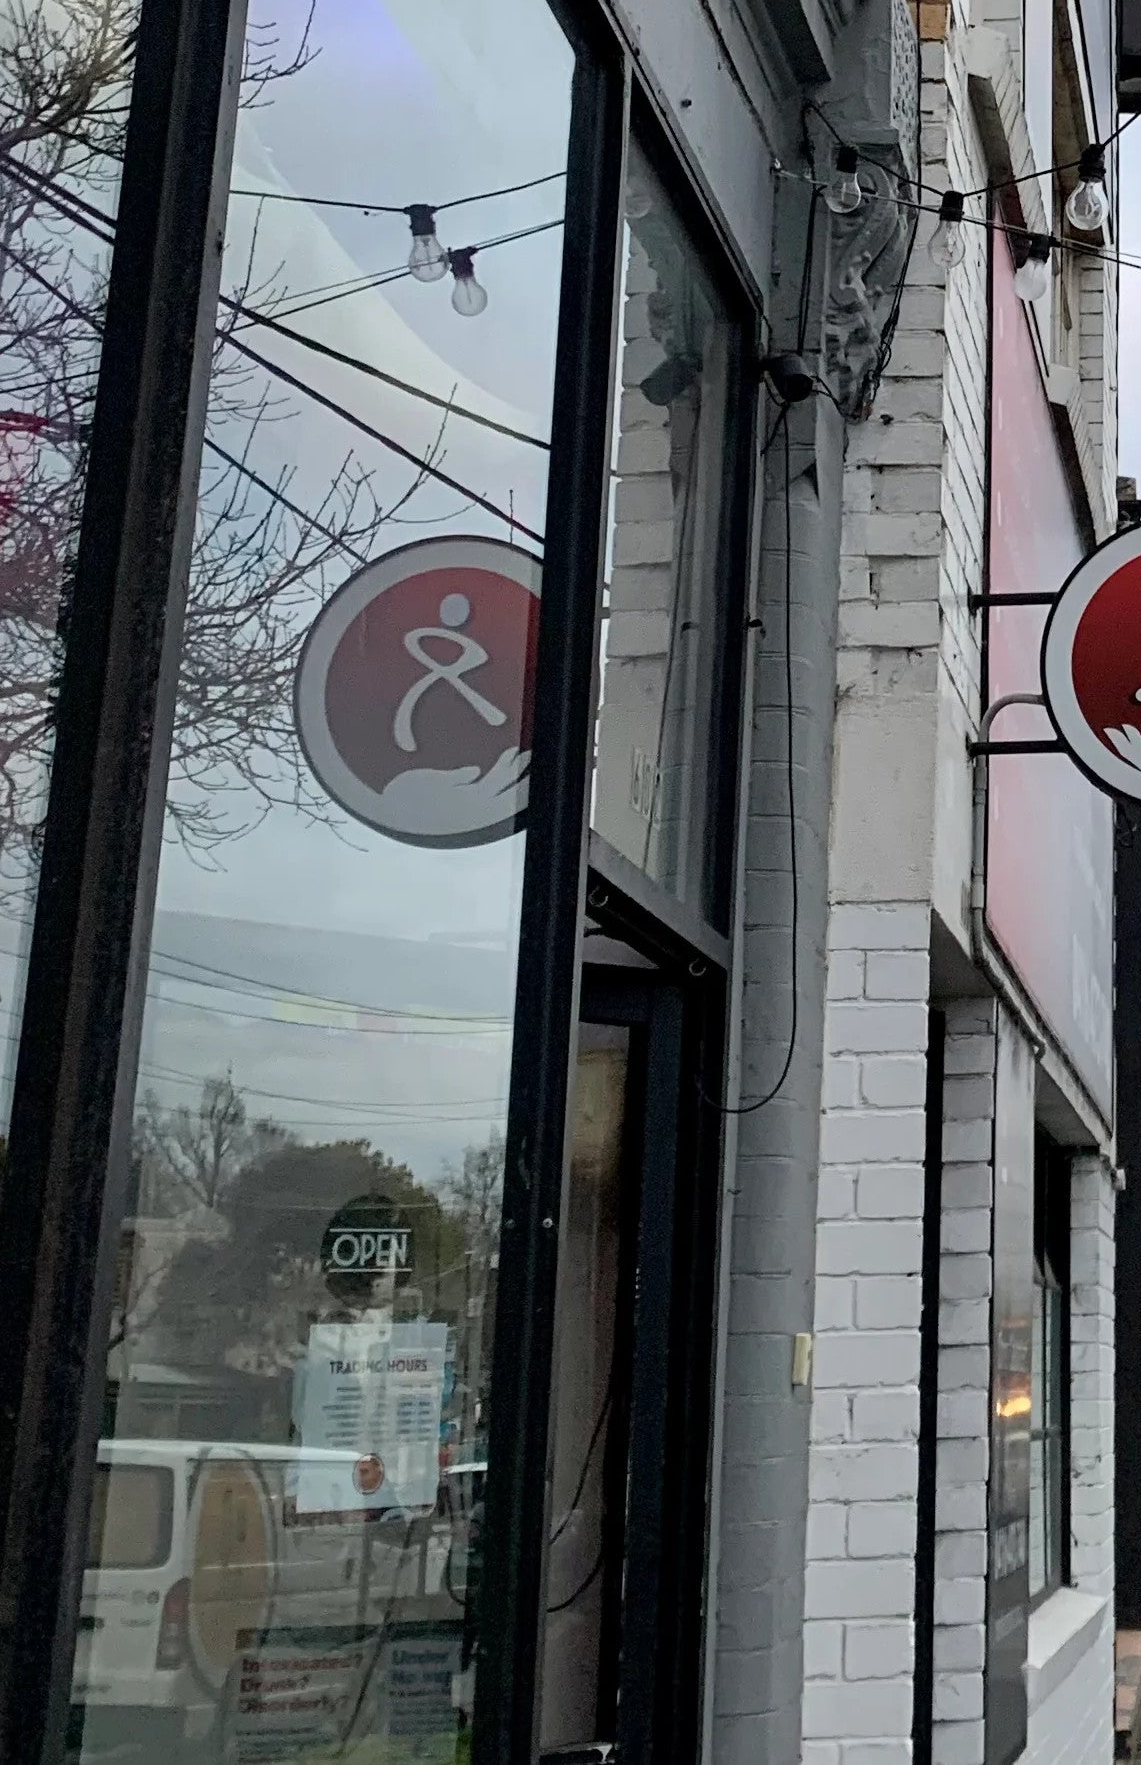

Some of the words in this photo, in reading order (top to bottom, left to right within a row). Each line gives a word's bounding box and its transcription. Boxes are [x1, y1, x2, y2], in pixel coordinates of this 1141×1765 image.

[331, 1233, 408, 1268] OPEN
[329, 1360, 383, 1376] TRADING
[386, 1358, 428, 1374] HOURS
